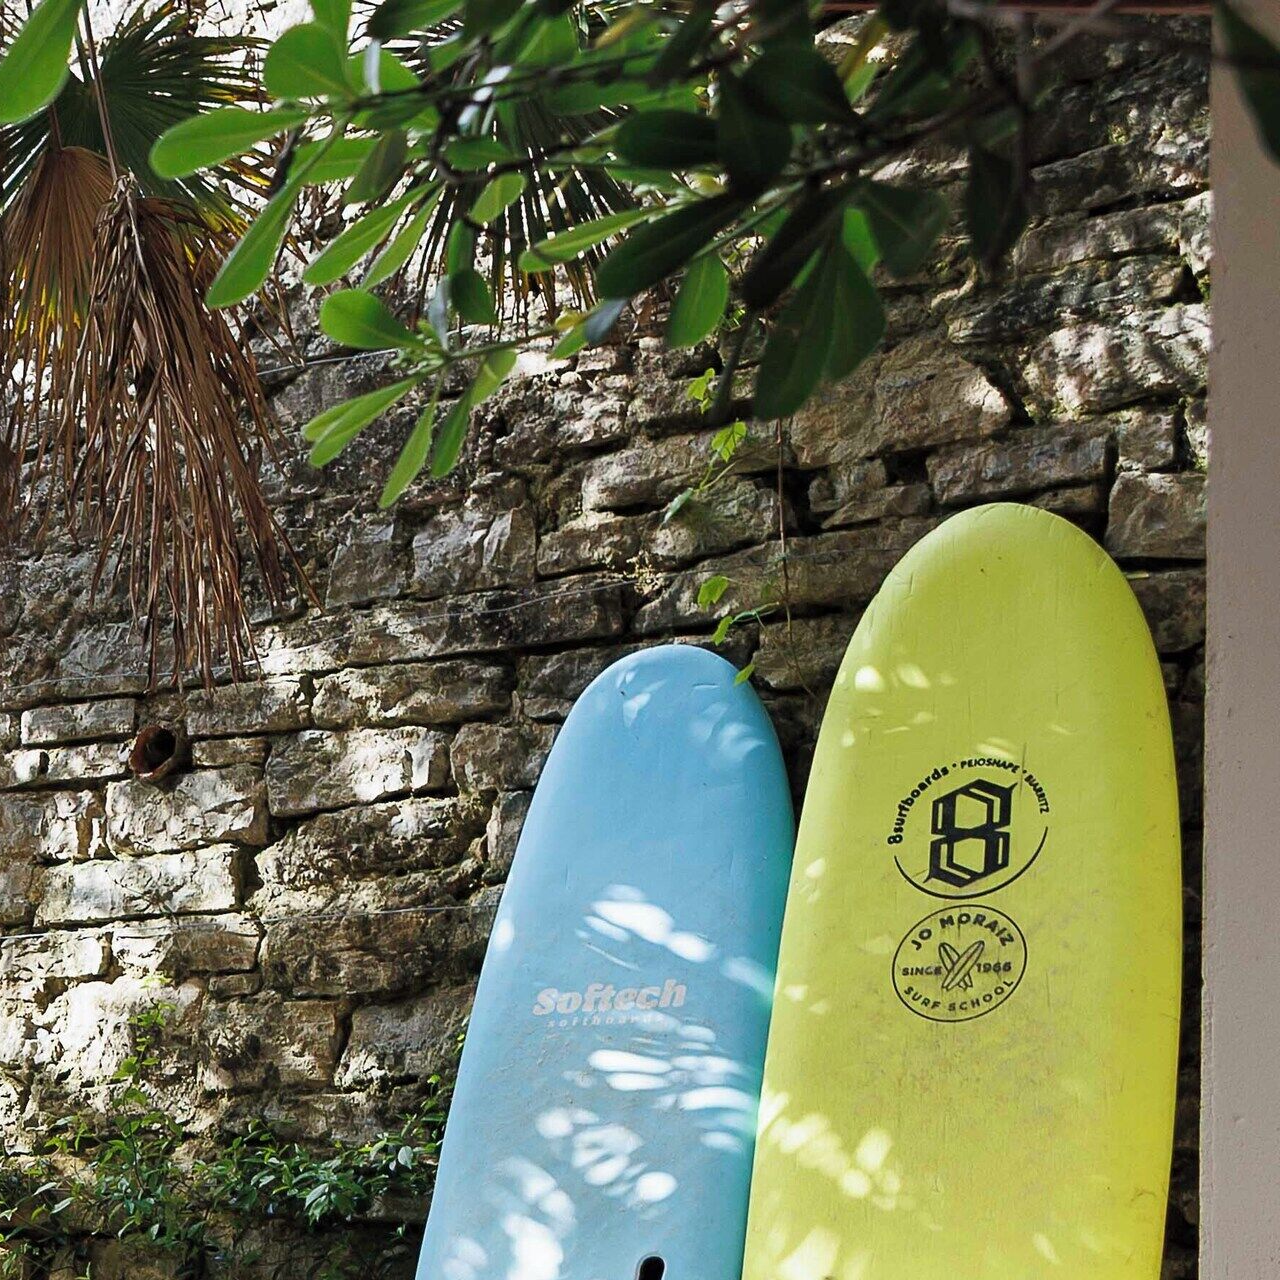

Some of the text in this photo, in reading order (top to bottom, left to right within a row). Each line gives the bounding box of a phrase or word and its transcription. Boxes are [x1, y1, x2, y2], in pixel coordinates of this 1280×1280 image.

[887, 767, 949, 845] 8surfboards
[1024, 774, 1050, 814] BIARRITZ
[911, 912, 1015, 951] JO MORAIZ
[902, 966, 942, 976] SINCE
[533, 979, 687, 1016] Softech
[904, 980, 1014, 1012] SURF SCHOOL
